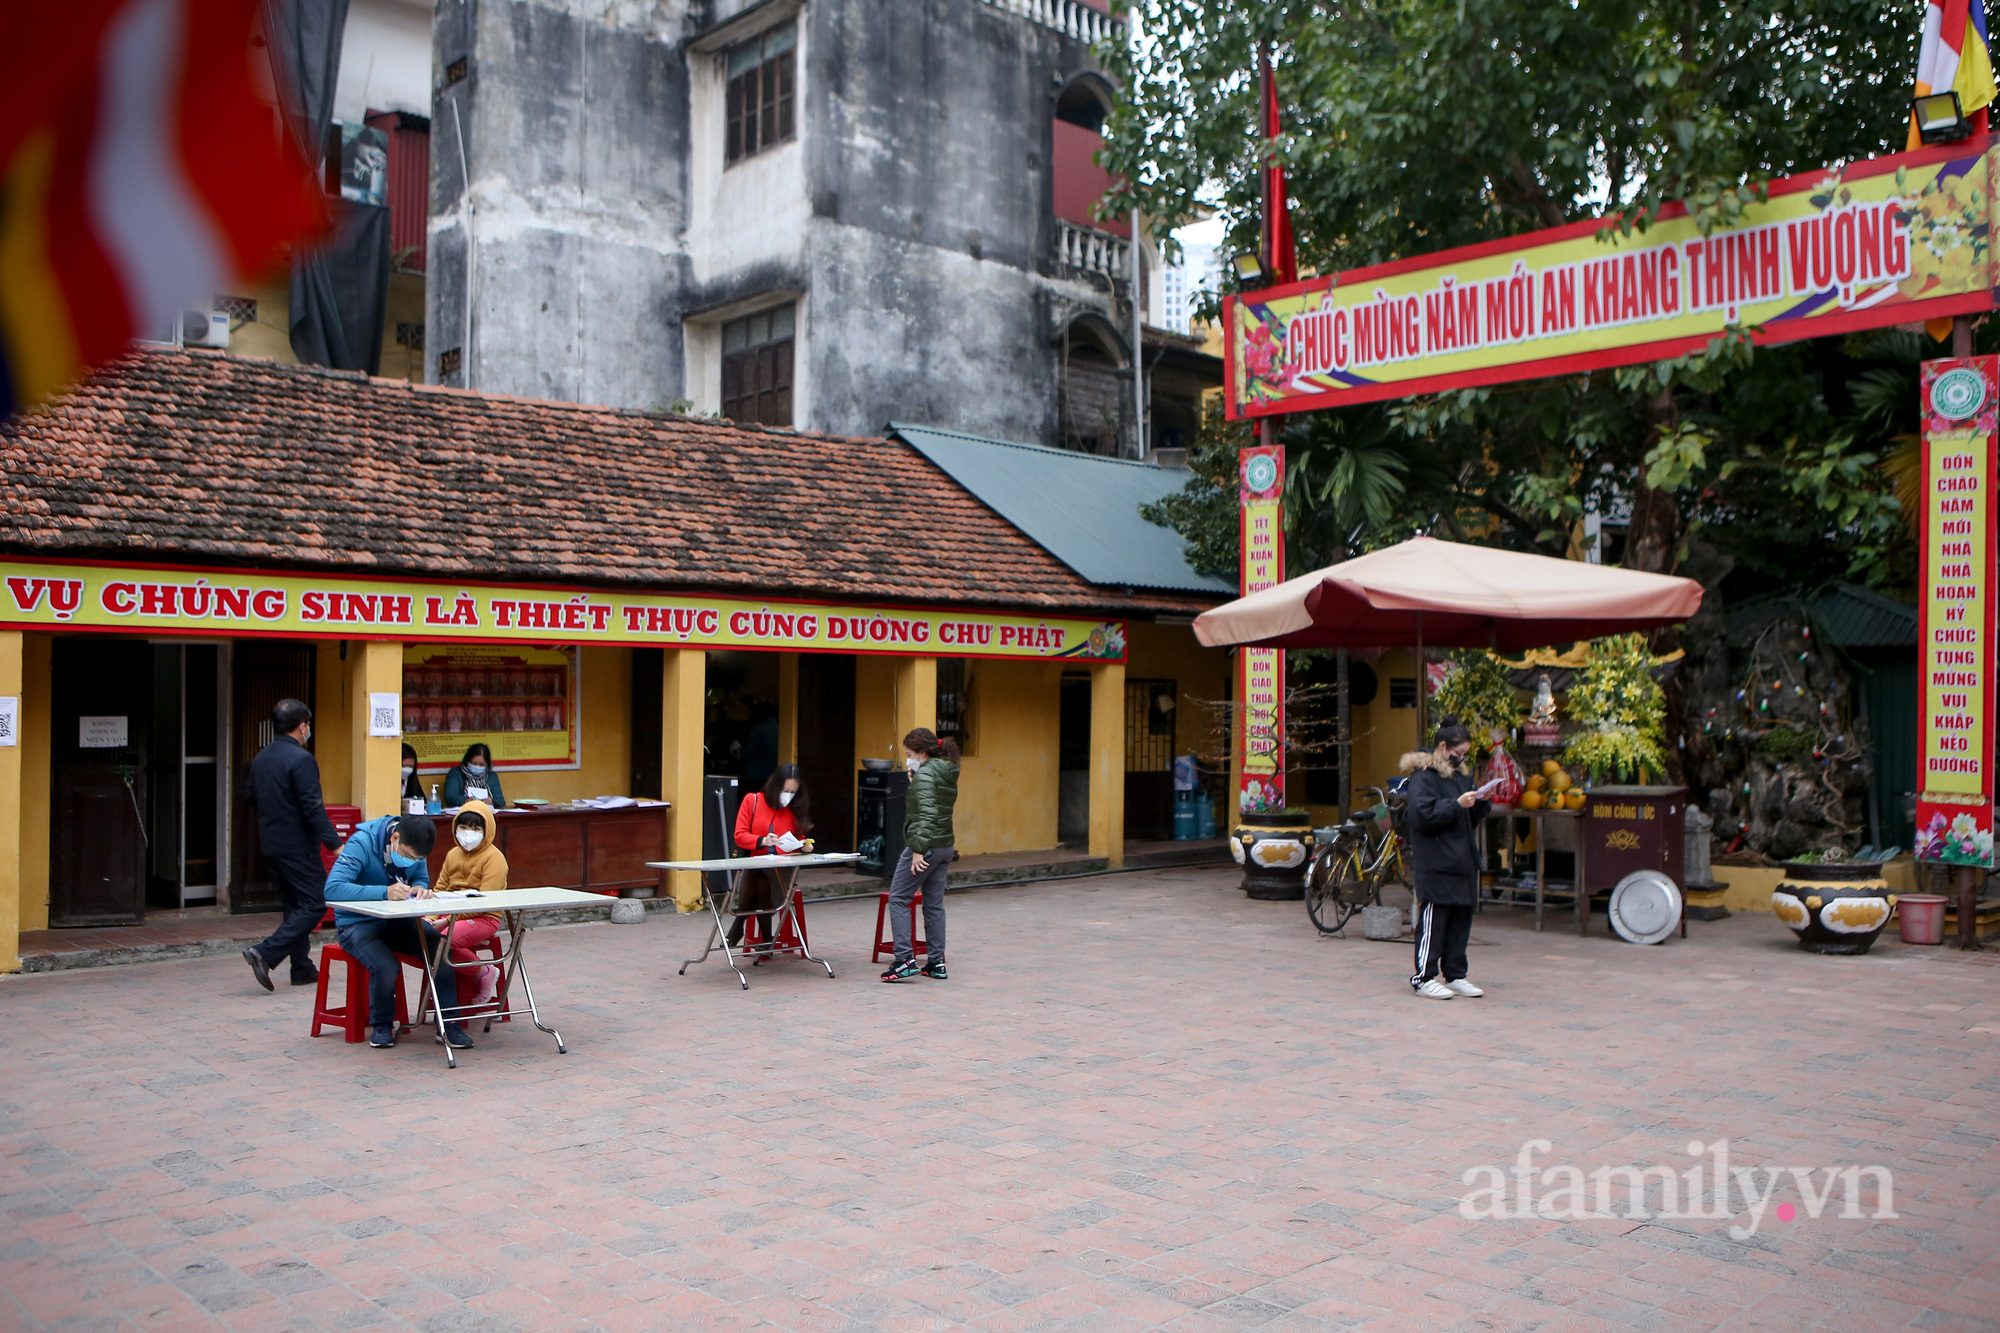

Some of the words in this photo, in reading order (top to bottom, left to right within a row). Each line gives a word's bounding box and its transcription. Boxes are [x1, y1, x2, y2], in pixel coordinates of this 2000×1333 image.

[1290, 296, 1349, 377] CHÚC
[1353, 291, 1420, 364] MỪNG
[1426, 276, 1479, 352] NĂM
[1485, 262, 1536, 345] MỚI
[1541, 266, 1576, 334] AN
[1583, 251, 1679, 326] KHANG
[1685, 227, 1781, 324] THỊNH
[1787, 201, 1908, 309] VƯỢNG
[1942, 453, 1974, 471] ĐÓN
[1937, 475, 1978, 492] CHÀO
[1940, 497, 1974, 513] NĂM
[1942, 518, 1971, 535] MỚI
[1941, 540, 1972, 556] NHÀ
[1941, 561, 1972, 578] NHÀ
[1935, 584, 1976, 600] HOAN
[5, 577, 84, 621] VỤ
[102, 579, 285, 619] CHÚNG
[301, 591, 412, 624] SINH
[425, 592, 479, 626] LÀ
[491, 595, 612, 631] THIẾT
[623, 606, 718, 639] THỰC
[729, 607, 818, 639] CÚNG
[827, 614, 930, 643] DƯỜNG
[938, 622, 994, 646] CHƯ
[999, 626, 1066, 655] PHẬT
[1934, 627, 1976, 643] CHÚC
[1935, 649, 1975, 668] TỤNG
[1941, 692, 1967, 708] VUI
[1928, 756, 1979, 774] ĐƯỜNG
[1593, 802, 1613, 819] HÒM
[1613, 803, 1637, 820] CÔNG
